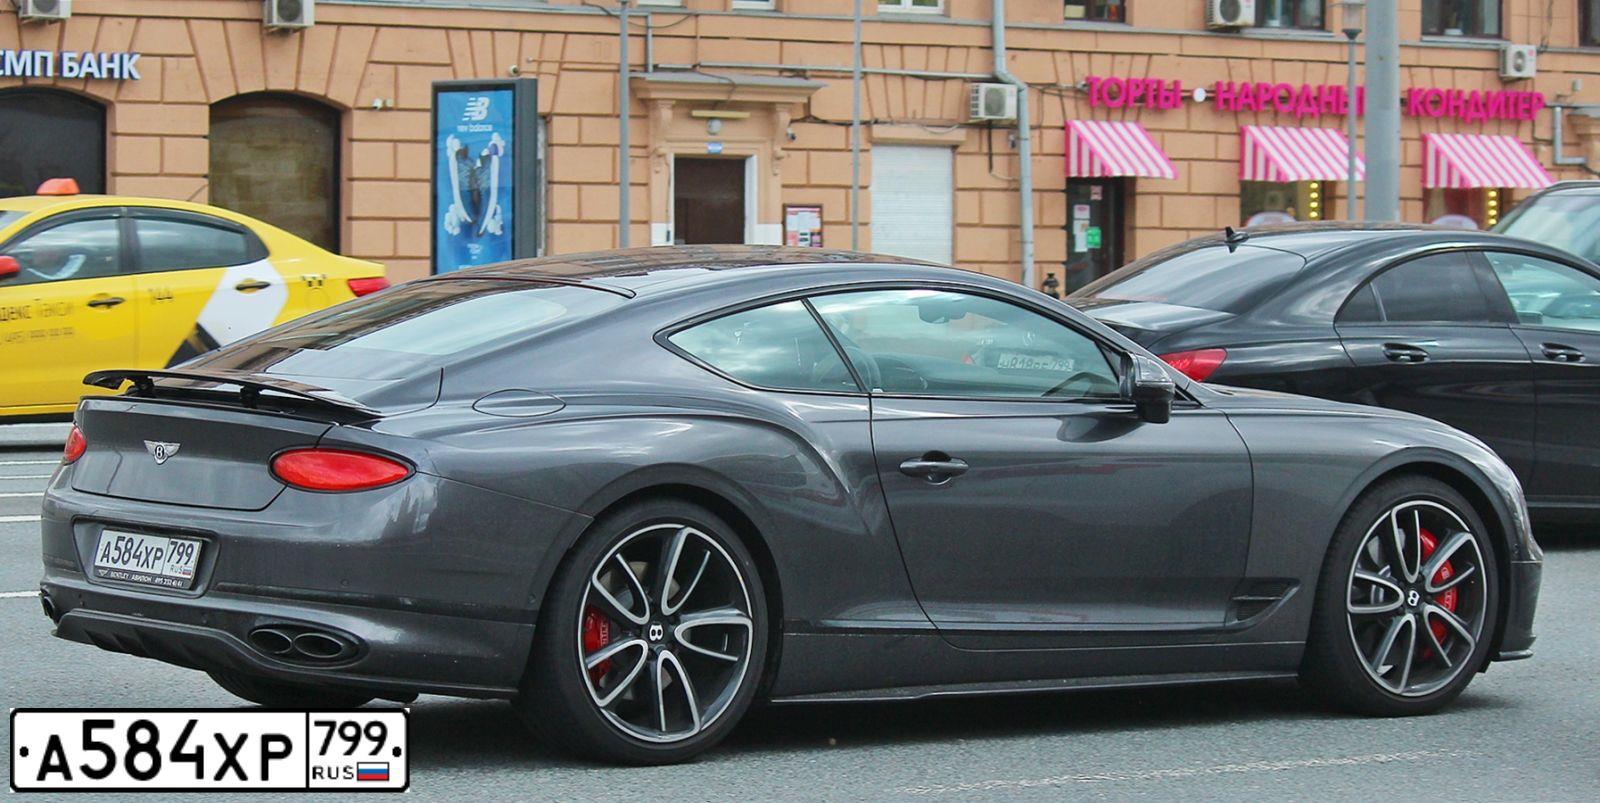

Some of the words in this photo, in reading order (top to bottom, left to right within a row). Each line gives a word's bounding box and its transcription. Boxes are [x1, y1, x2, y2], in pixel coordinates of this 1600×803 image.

[61, 51, 141, 80] БАНК
[1086, 75, 1183, 110] ТОРТЫ
[1213, 80, 1366, 119] НАРОДНЫ
[1407, 87, 1546, 125] КОНДИТЕР
[100, 535, 164, 570] А584ХР
[167, 540, 195, 566] 799
